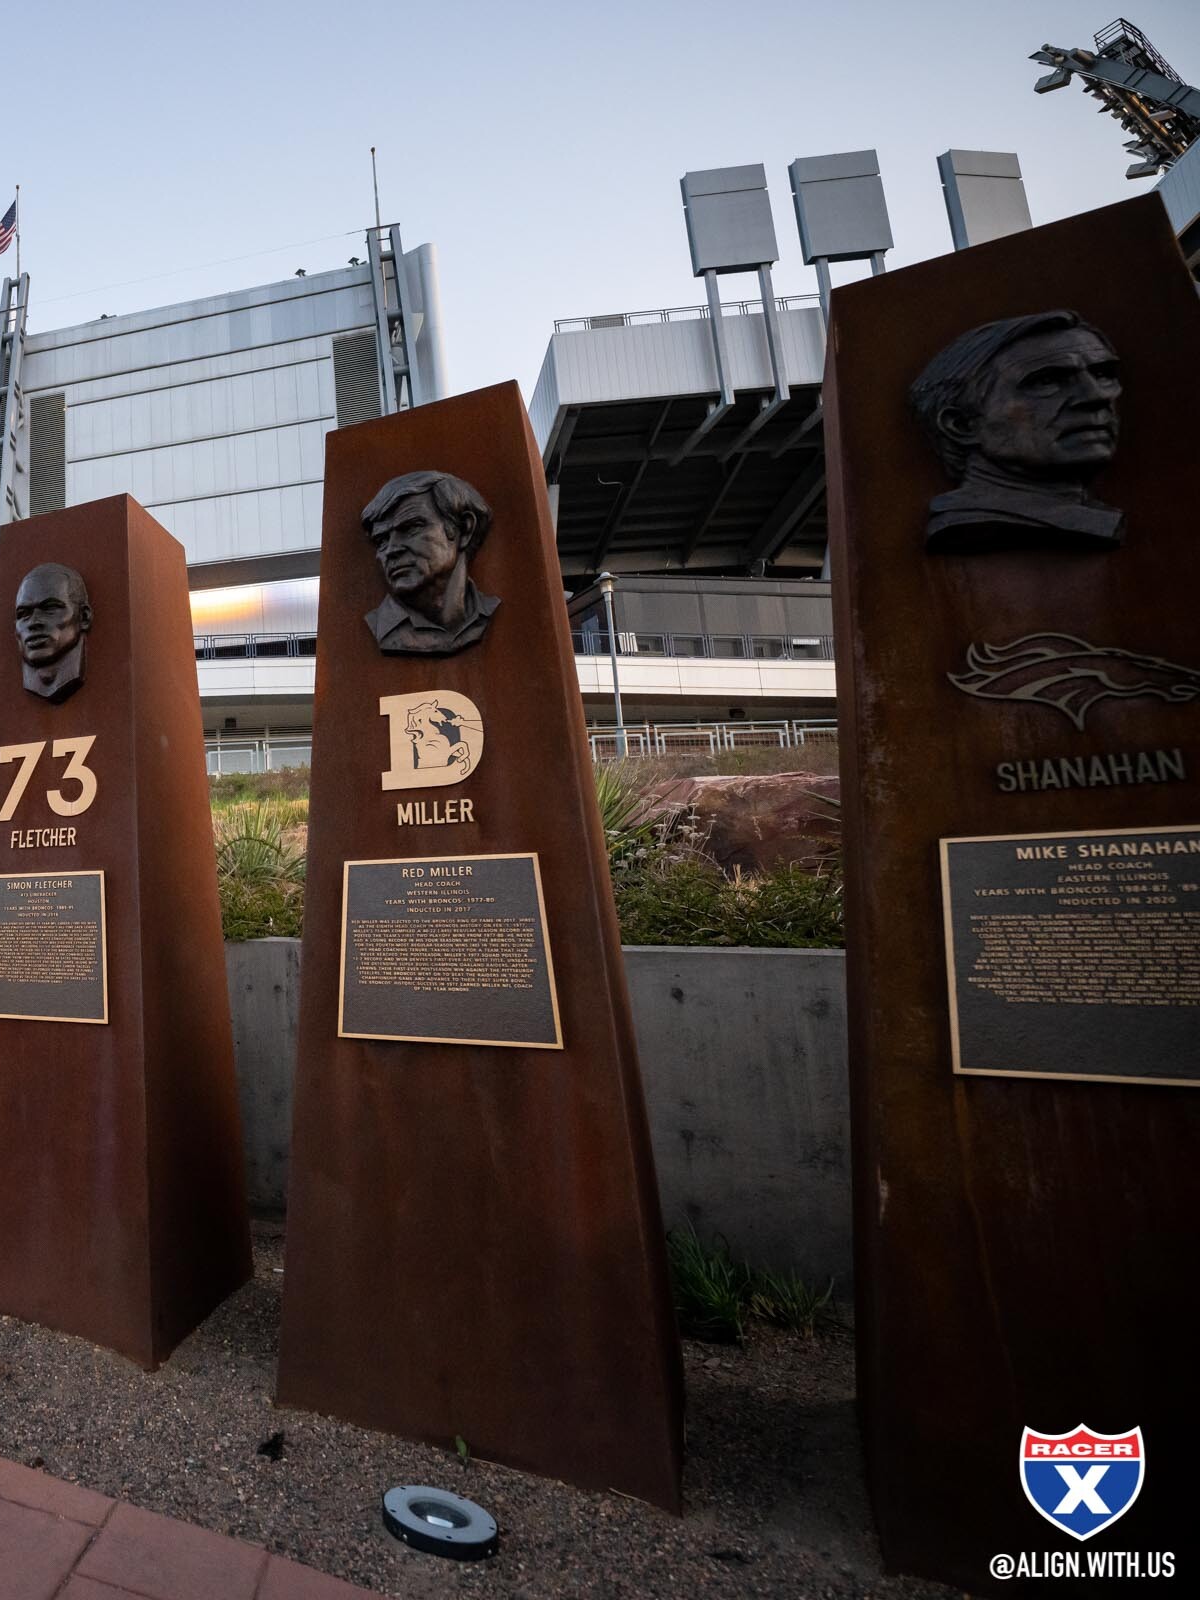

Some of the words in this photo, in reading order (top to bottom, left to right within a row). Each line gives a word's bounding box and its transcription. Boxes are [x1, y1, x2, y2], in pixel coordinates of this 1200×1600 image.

[996, 748, 1187, 792] SHANAHAN
[397, 798, 475, 826] MILLER
[10, 826, 77, 849] FLETCHER
[1016, 846, 1068, 860] MIKE
[1077, 840, 1200, 858] SHANAHAN
[1068, 862, 1103, 871] HEAD
[1107, 861, 1153, 870] COACH
[402, 868, 425, 878] RED
[430, 866, 473, 877] MILLER
[1057, 874, 1111, 883] EASTERN
[1115, 872, 1169, 882] ILLINOIS
[6, 881, 32, 890] SIMON
[34, 880, 73, 889] FLETCHER
[974, 888, 1011, 897] YEARS
[1014, 887, 1046, 896] WITH
[1058, 896, 1121, 905] INDUCTED
[1126, 896, 1141, 904] IN
